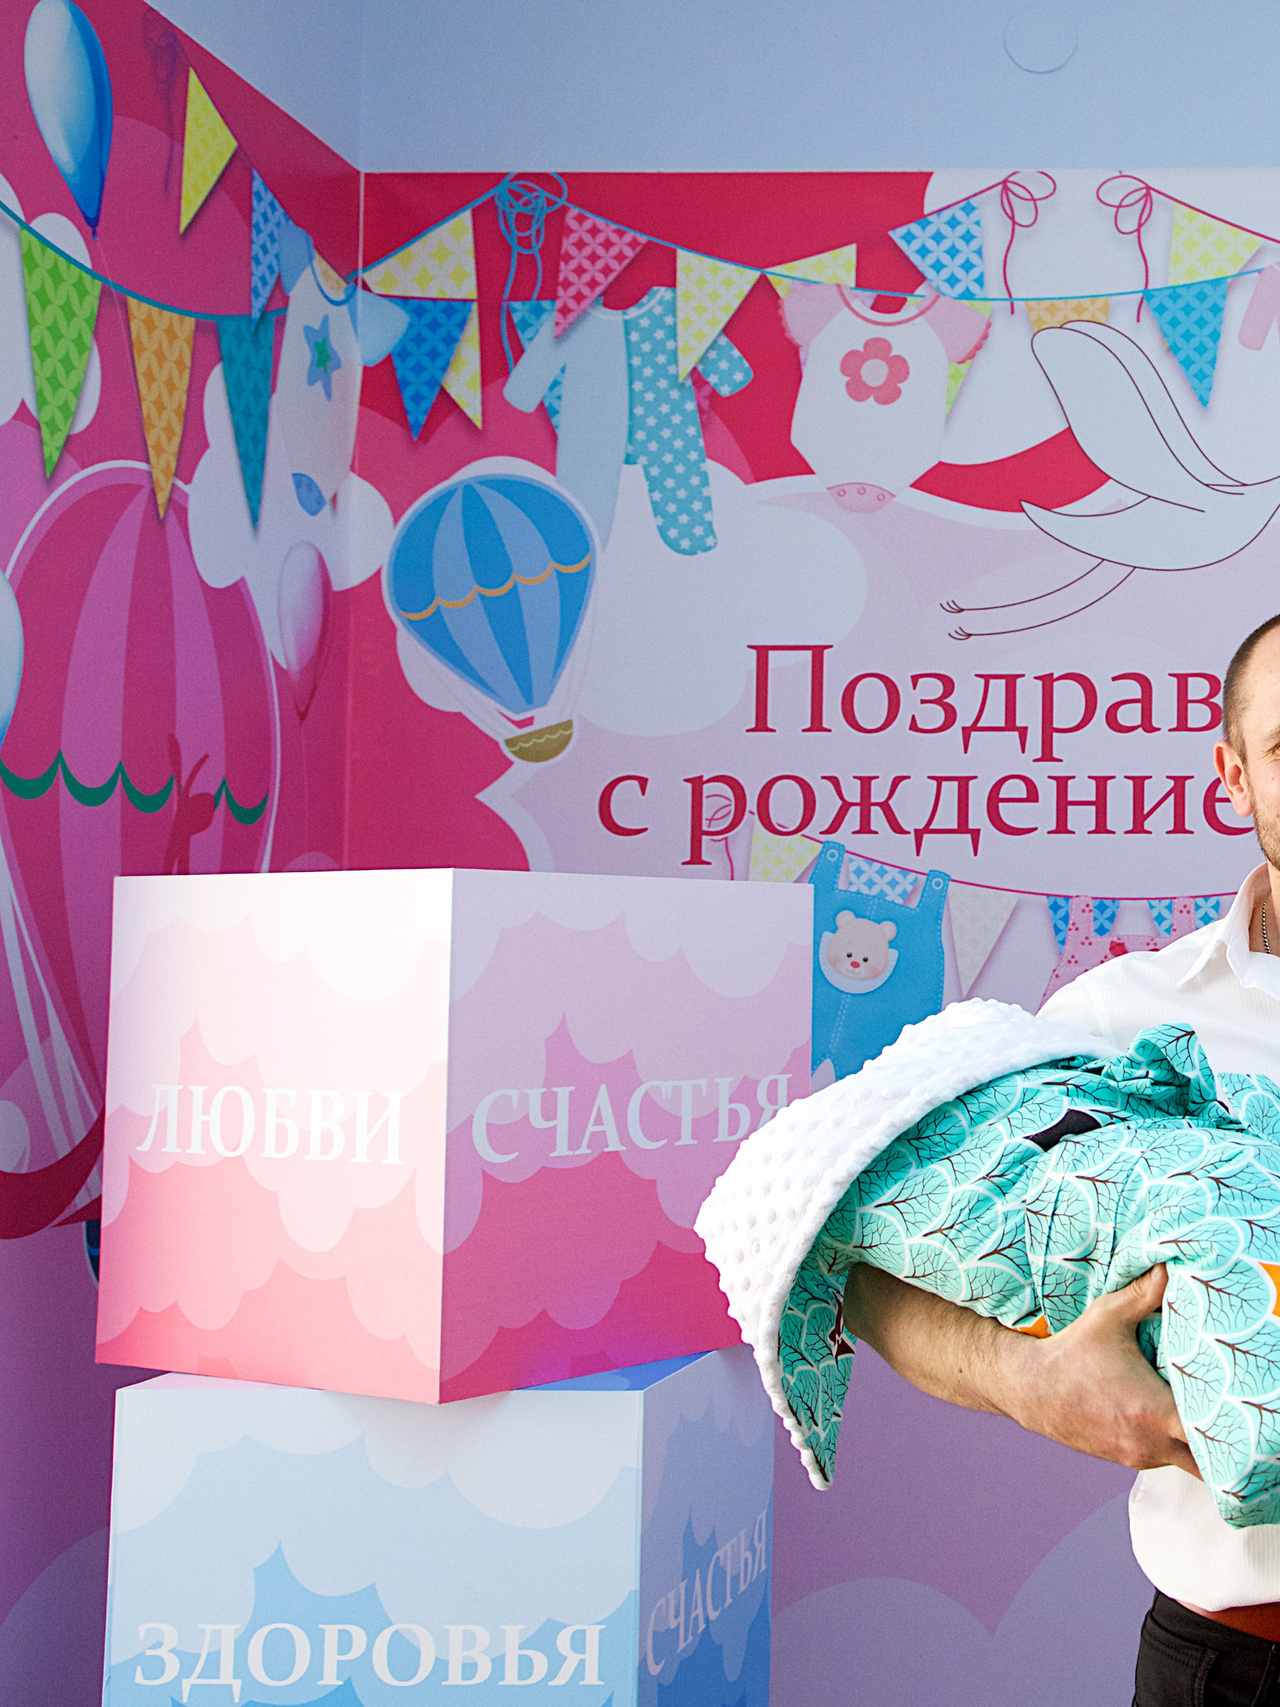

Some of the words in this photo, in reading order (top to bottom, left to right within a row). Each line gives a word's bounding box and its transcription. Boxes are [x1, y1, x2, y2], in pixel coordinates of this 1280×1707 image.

[598, 774, 649, 837] с
[681, 774, 1256, 866] рождение
[136, 1083, 405, 1165] ЛЮБВИ
[472, 1073, 792, 1164] СЧАСТЬЯ
[647, 1509, 767, 1676] СЧАСТЬЯ
[134, 1621, 606, 1703] ЗДОРОВЬЯ
